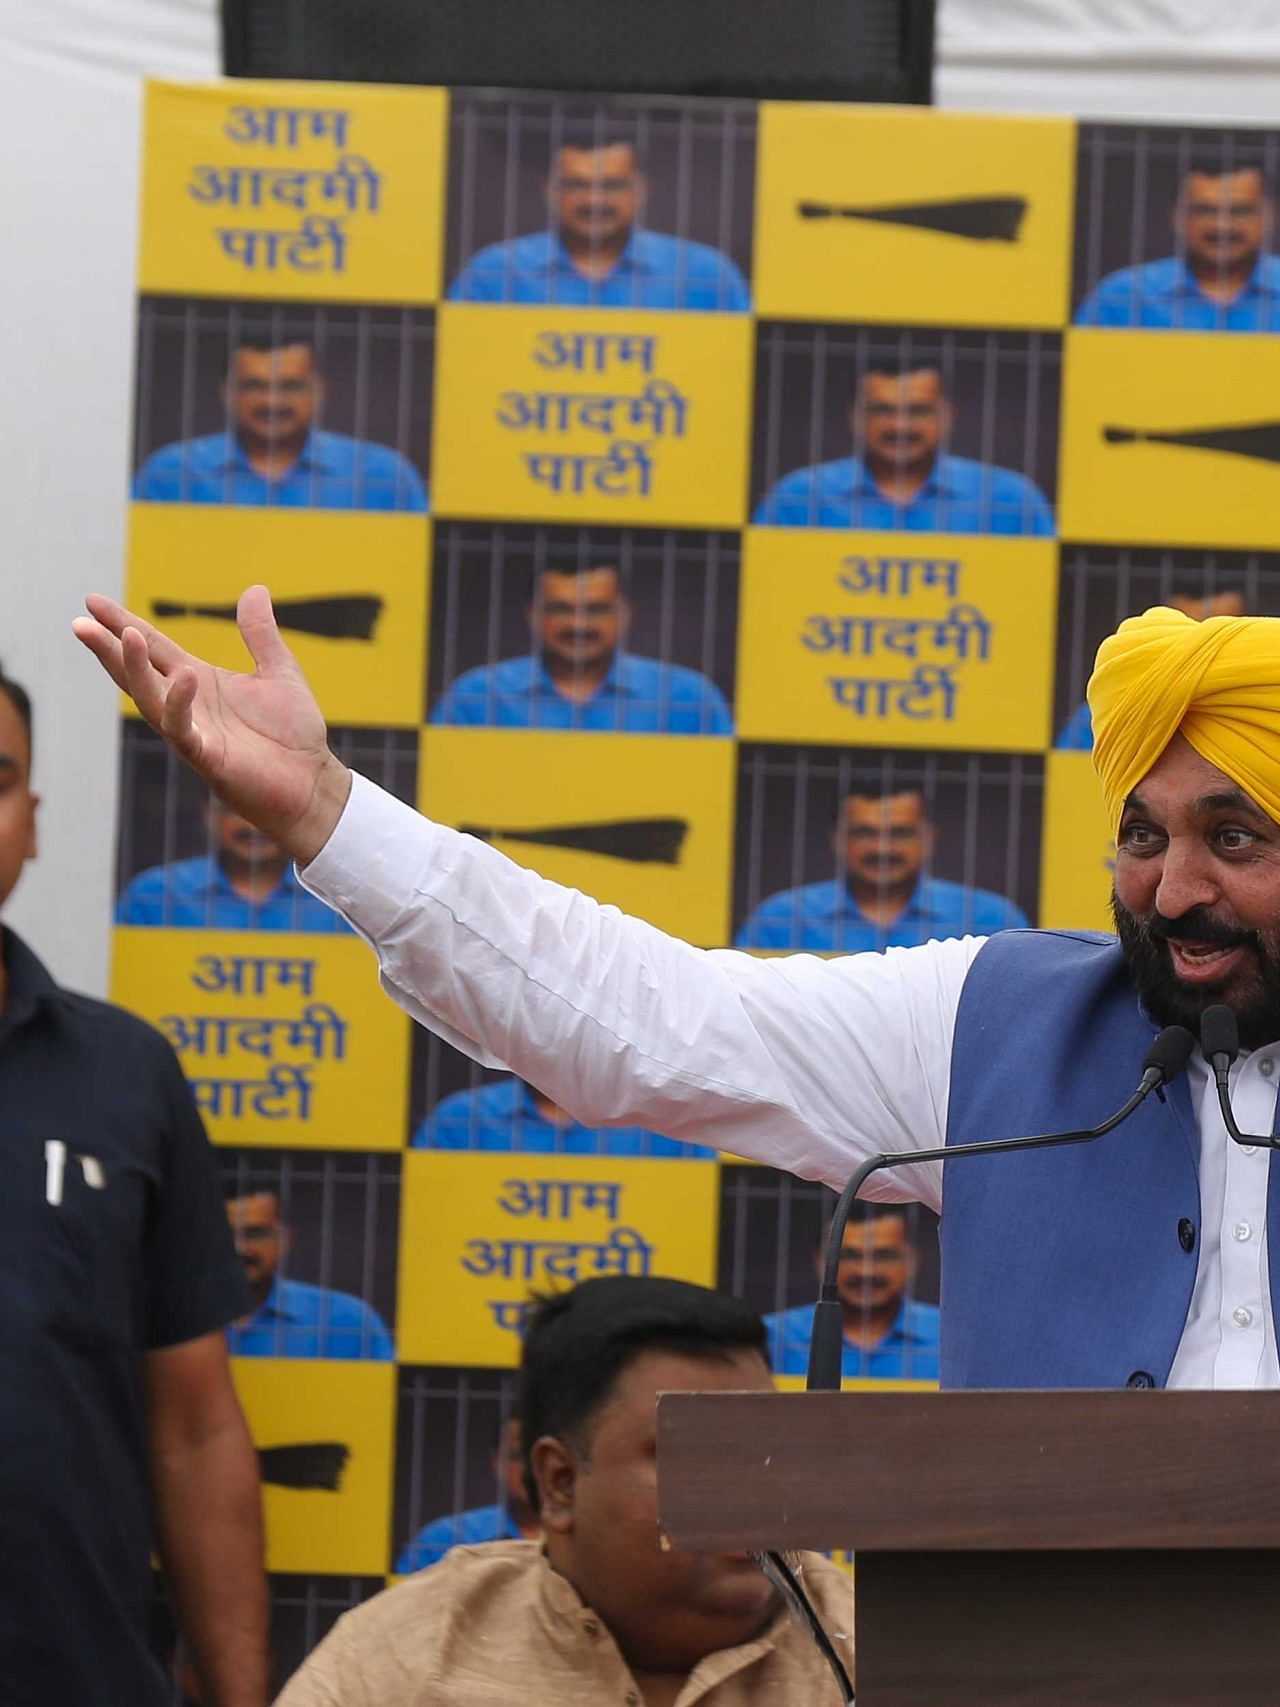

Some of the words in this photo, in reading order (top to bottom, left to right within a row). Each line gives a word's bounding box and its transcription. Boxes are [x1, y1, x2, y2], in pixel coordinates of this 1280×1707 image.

[226, 108, 350, 149] आम
[190, 155, 382, 212] आदमी
[219, 215, 347, 273] पार्टी
[534, 333, 656, 376] आम
[498, 383, 689, 438] आदमी
[524, 440, 654, 496] पार्टी
[840, 556, 961, 599] आम
[802, 604, 993, 661] आदमी
[828, 664, 958, 720] पार्टी
[192, 955, 317, 996] आम
[161, 1003, 348, 1060] आदमी
[499, 1179, 623, 1220] आम
